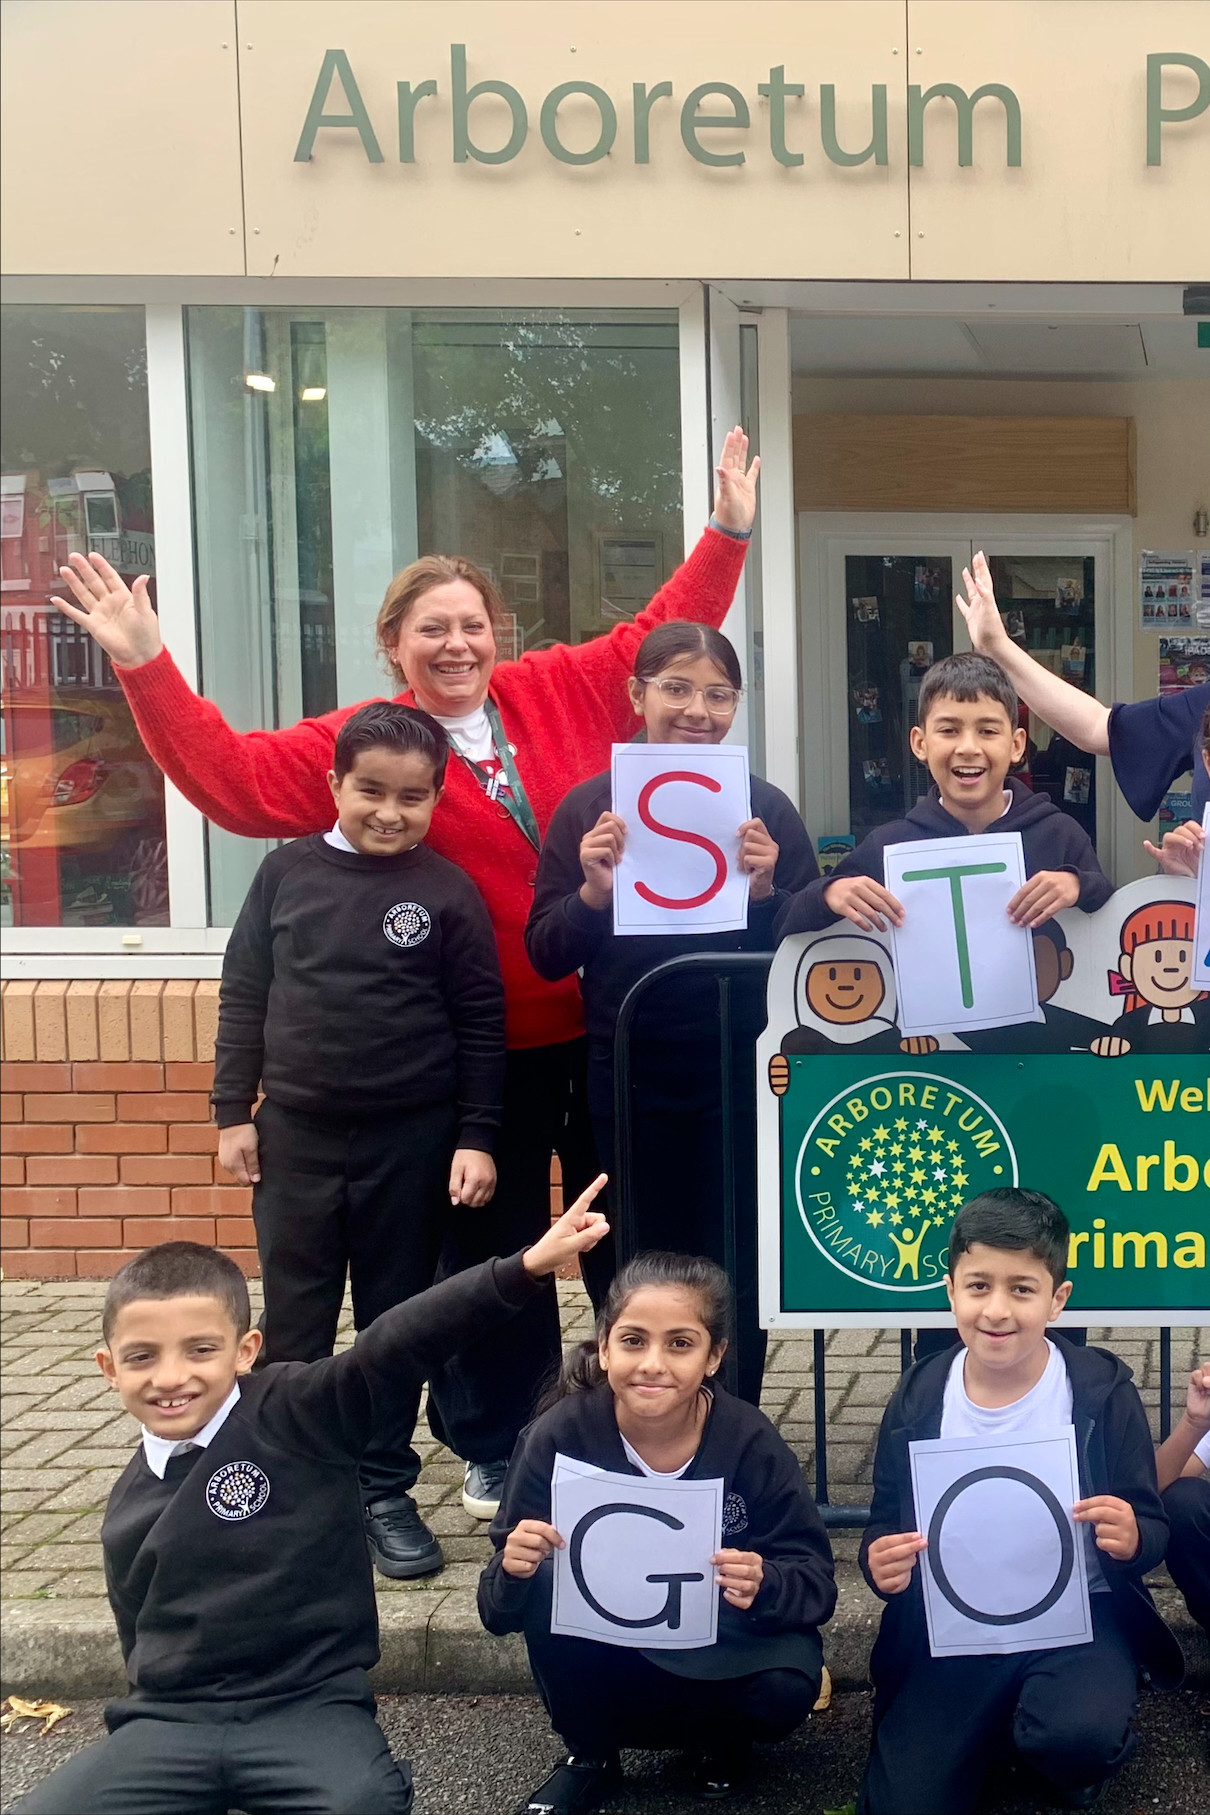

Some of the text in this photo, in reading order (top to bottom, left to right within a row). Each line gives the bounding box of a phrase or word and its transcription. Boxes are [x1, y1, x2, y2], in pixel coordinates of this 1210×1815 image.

[294, 44, 1022, 167] Arboretum
[388, 904, 428, 923] ARBORETUM
[635, 771, 728, 910] S
[902, 862, 1007, 1009] T
[815, 1083, 1001, 1158] ARBORETUM
[808, 1191, 896, 1278] PRIMARY
[209, 1463, 260, 1495] ARBORETUM
[213, 1482, 267, 1518] PRIMARY SCHOOL
[569, 1502, 705, 1630] G
[928, 1465, 1075, 1626] O
